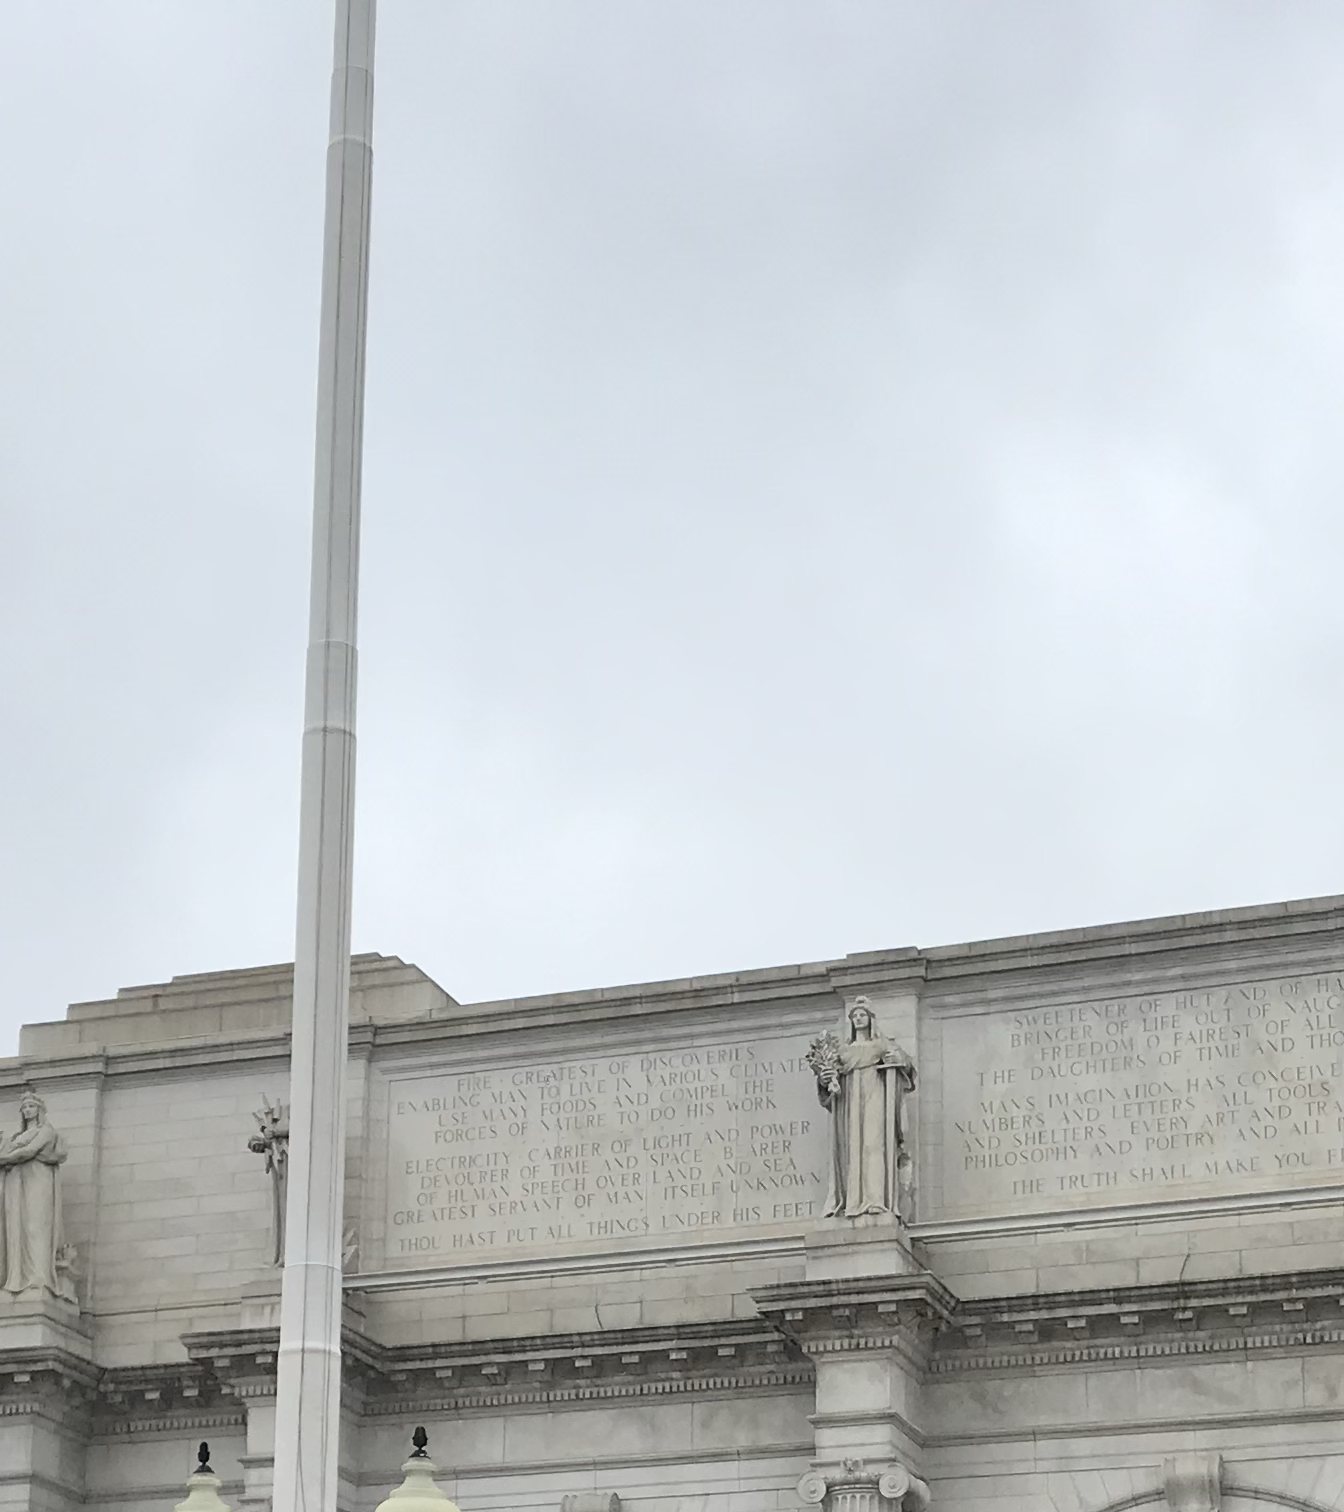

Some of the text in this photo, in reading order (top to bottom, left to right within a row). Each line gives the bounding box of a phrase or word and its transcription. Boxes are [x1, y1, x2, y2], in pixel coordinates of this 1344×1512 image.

[1010, 1003, 1271, 1047] BRINGER OF LIFE OUT OF
[1040, 1013, 1336, 1060] FREEDOM FAIREST OF ALL
[457, 1076, 491, 1091] FIRE
[608, 1061, 628, 1074] OF
[976, 1068, 1016, 1086] THE
[1030, 1054, 1145, 1080] DAUGHTERS
[1158, 1049, 1181, 1065] OF
[1195, 1043, 1241, 1061] TIME
[1254, 1037, 1294, 1054] AND
[1186, 1074, 1225, 1092] HAS
[537, 1085, 560, 1100] TO
[569, 1079, 605, 1096] LIVE
[616, 1077, 631, 1091] IN
[540, 1078, 773, 1116] FOODS AND COMPEL THE
[1062, 1107, 1100, 1124] AND
[1112, 1096, 1194, 1118] LETTERS
[1222, 1090, 1254, 1106] ALL
[1266, 1081, 1330, 1102] TOOLS
[434, 1125, 497, 1143] FORCES
[508, 1121, 528, 1136] OF
[616, 1110, 639, 1124] TO
[650, 1106, 675, 1121] DO
[686, 1102, 714, 1117] HIS
[963, 1135, 1000, 1152] AND
[1012, 1124, 1106, 1147] SHELTERS
[1130, 1116, 1187, 1134] EVERY
[1200, 1109, 1239, 1128] ART
[1248, 1104, 1291, 1122] AND
[964, 1145, 1076, 1169] PHILOSOPHY
[1090, 1140, 1132, 1157] AND
[1145, 1131, 1214, 1150] POETRY
[1236, 1124, 1277, 1141] AND
[1290, 1119, 1324, 1135] ALL
[405, 1120, 810, 1174] ELECTRICITY CARRIER OF LIGHT AND POWER
[519, 1149, 702, 1178] OF TIME AND SPACE
[416, 1157, 796, 1205] OF SPEECH OVER LAND AND SEA
[1012, 1178, 1044, 1194] THE
[1056, 1171, 1117, 1190] TRUTH
[1274, 1151, 1312, 1168] YOU
[574, 1193, 595, 1208] OF
[606, 1188, 644, 1204] MAN
[664, 1181, 720, 1199] ITSELF
[399, 1200, 816, 1251] THOU HAST PUT ALL THINGS UNDER HIS FEET
